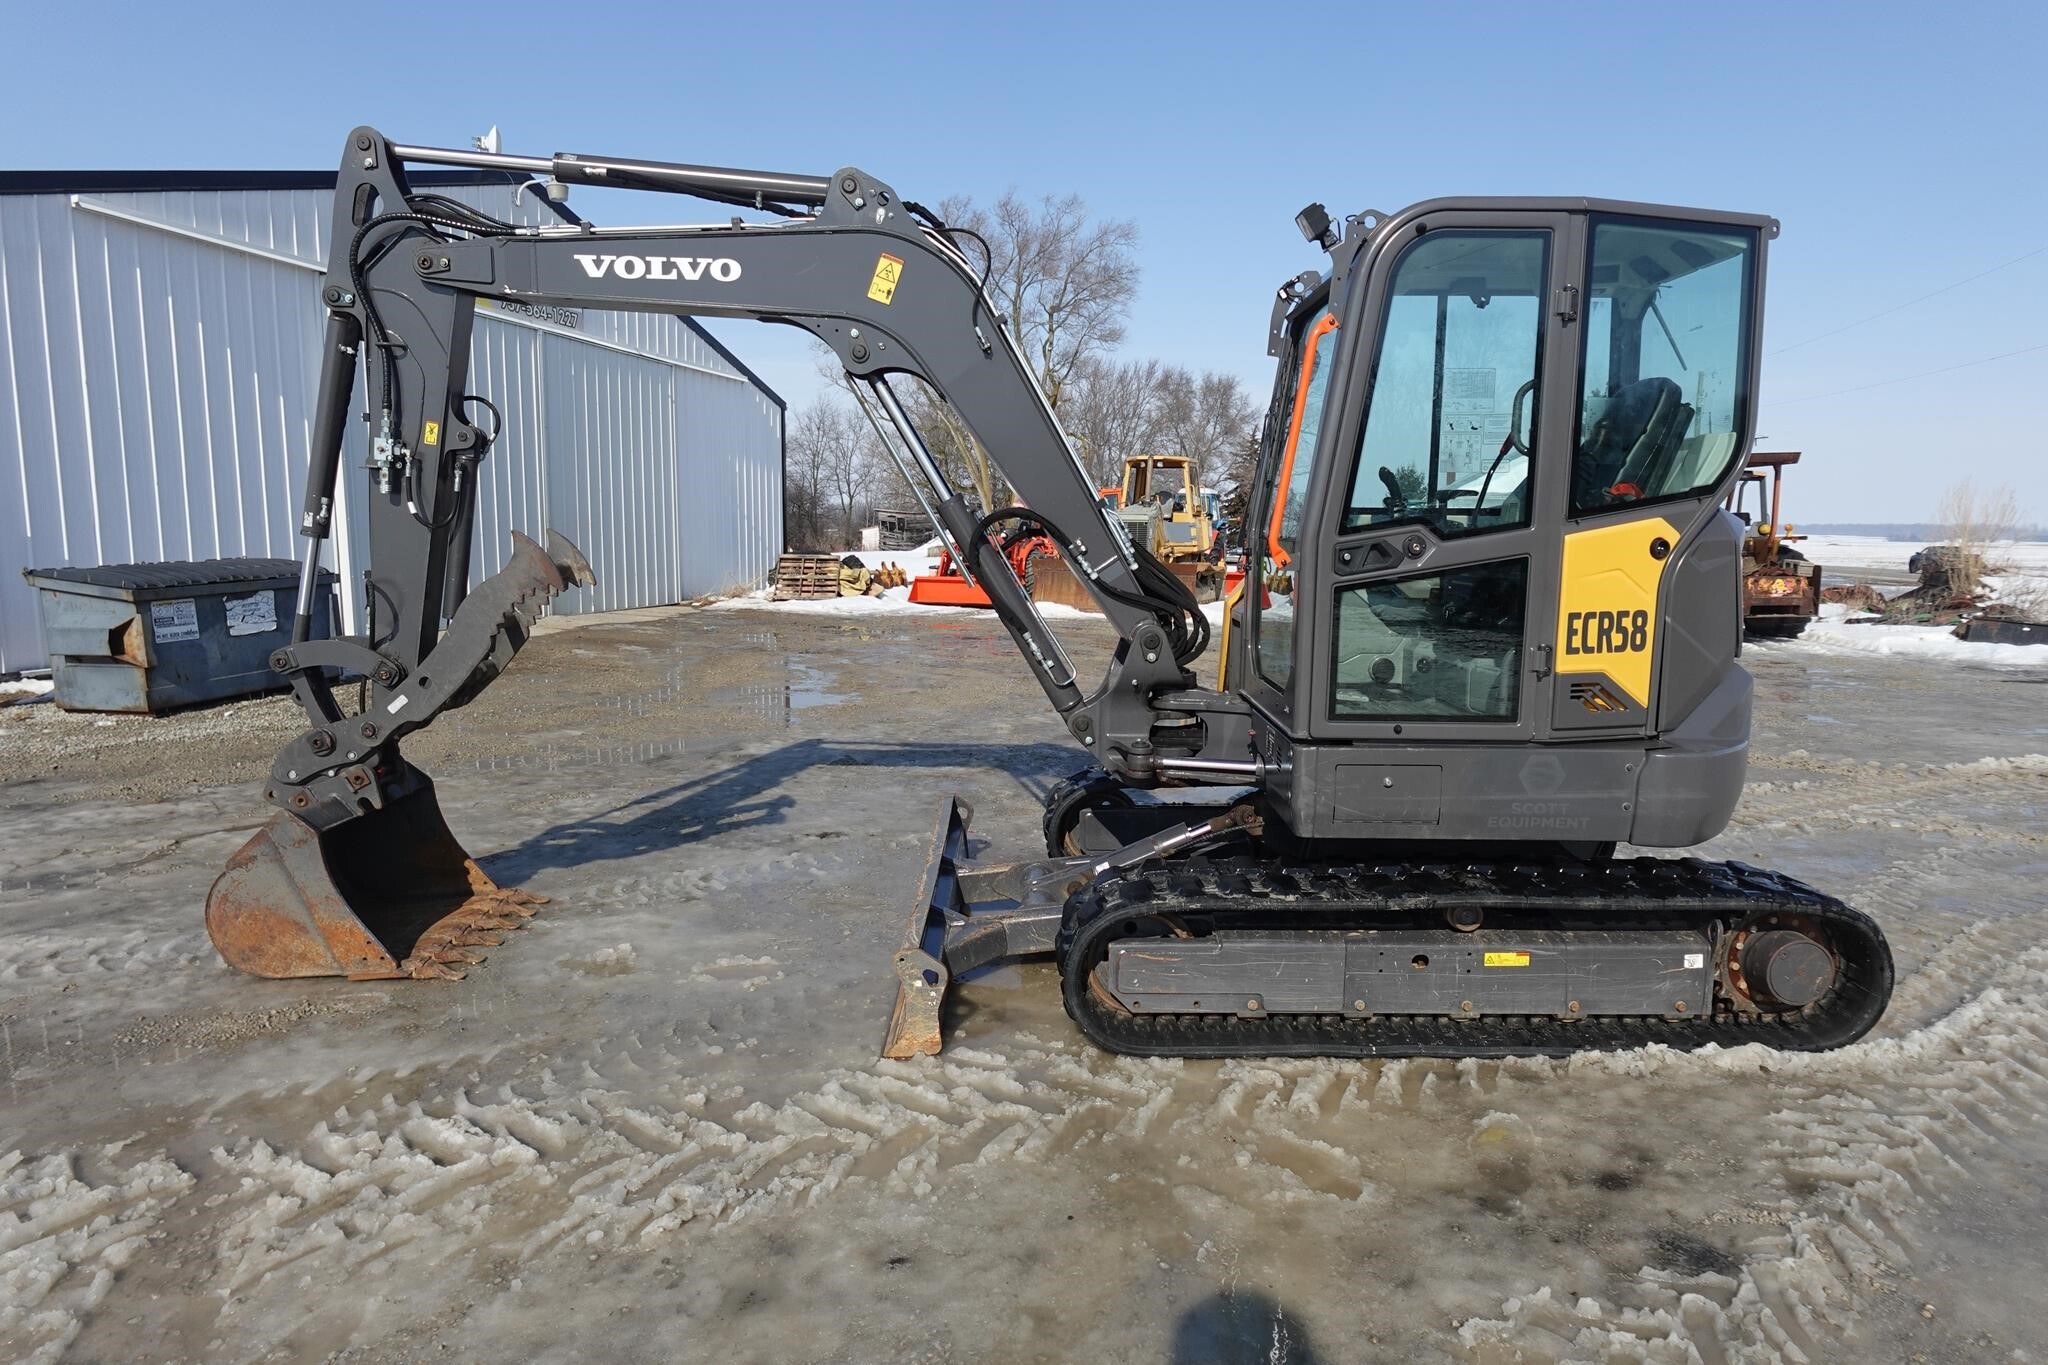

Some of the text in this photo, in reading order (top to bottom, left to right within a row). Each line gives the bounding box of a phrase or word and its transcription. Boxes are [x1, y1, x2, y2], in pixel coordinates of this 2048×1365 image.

[573, 254, 742, 282] VOLVO
[1565, 609, 1648, 655] ECR58
[1511, 802, 1570, 815] SCOTT
[1487, 816, 1591, 829] EQUIPMENT
